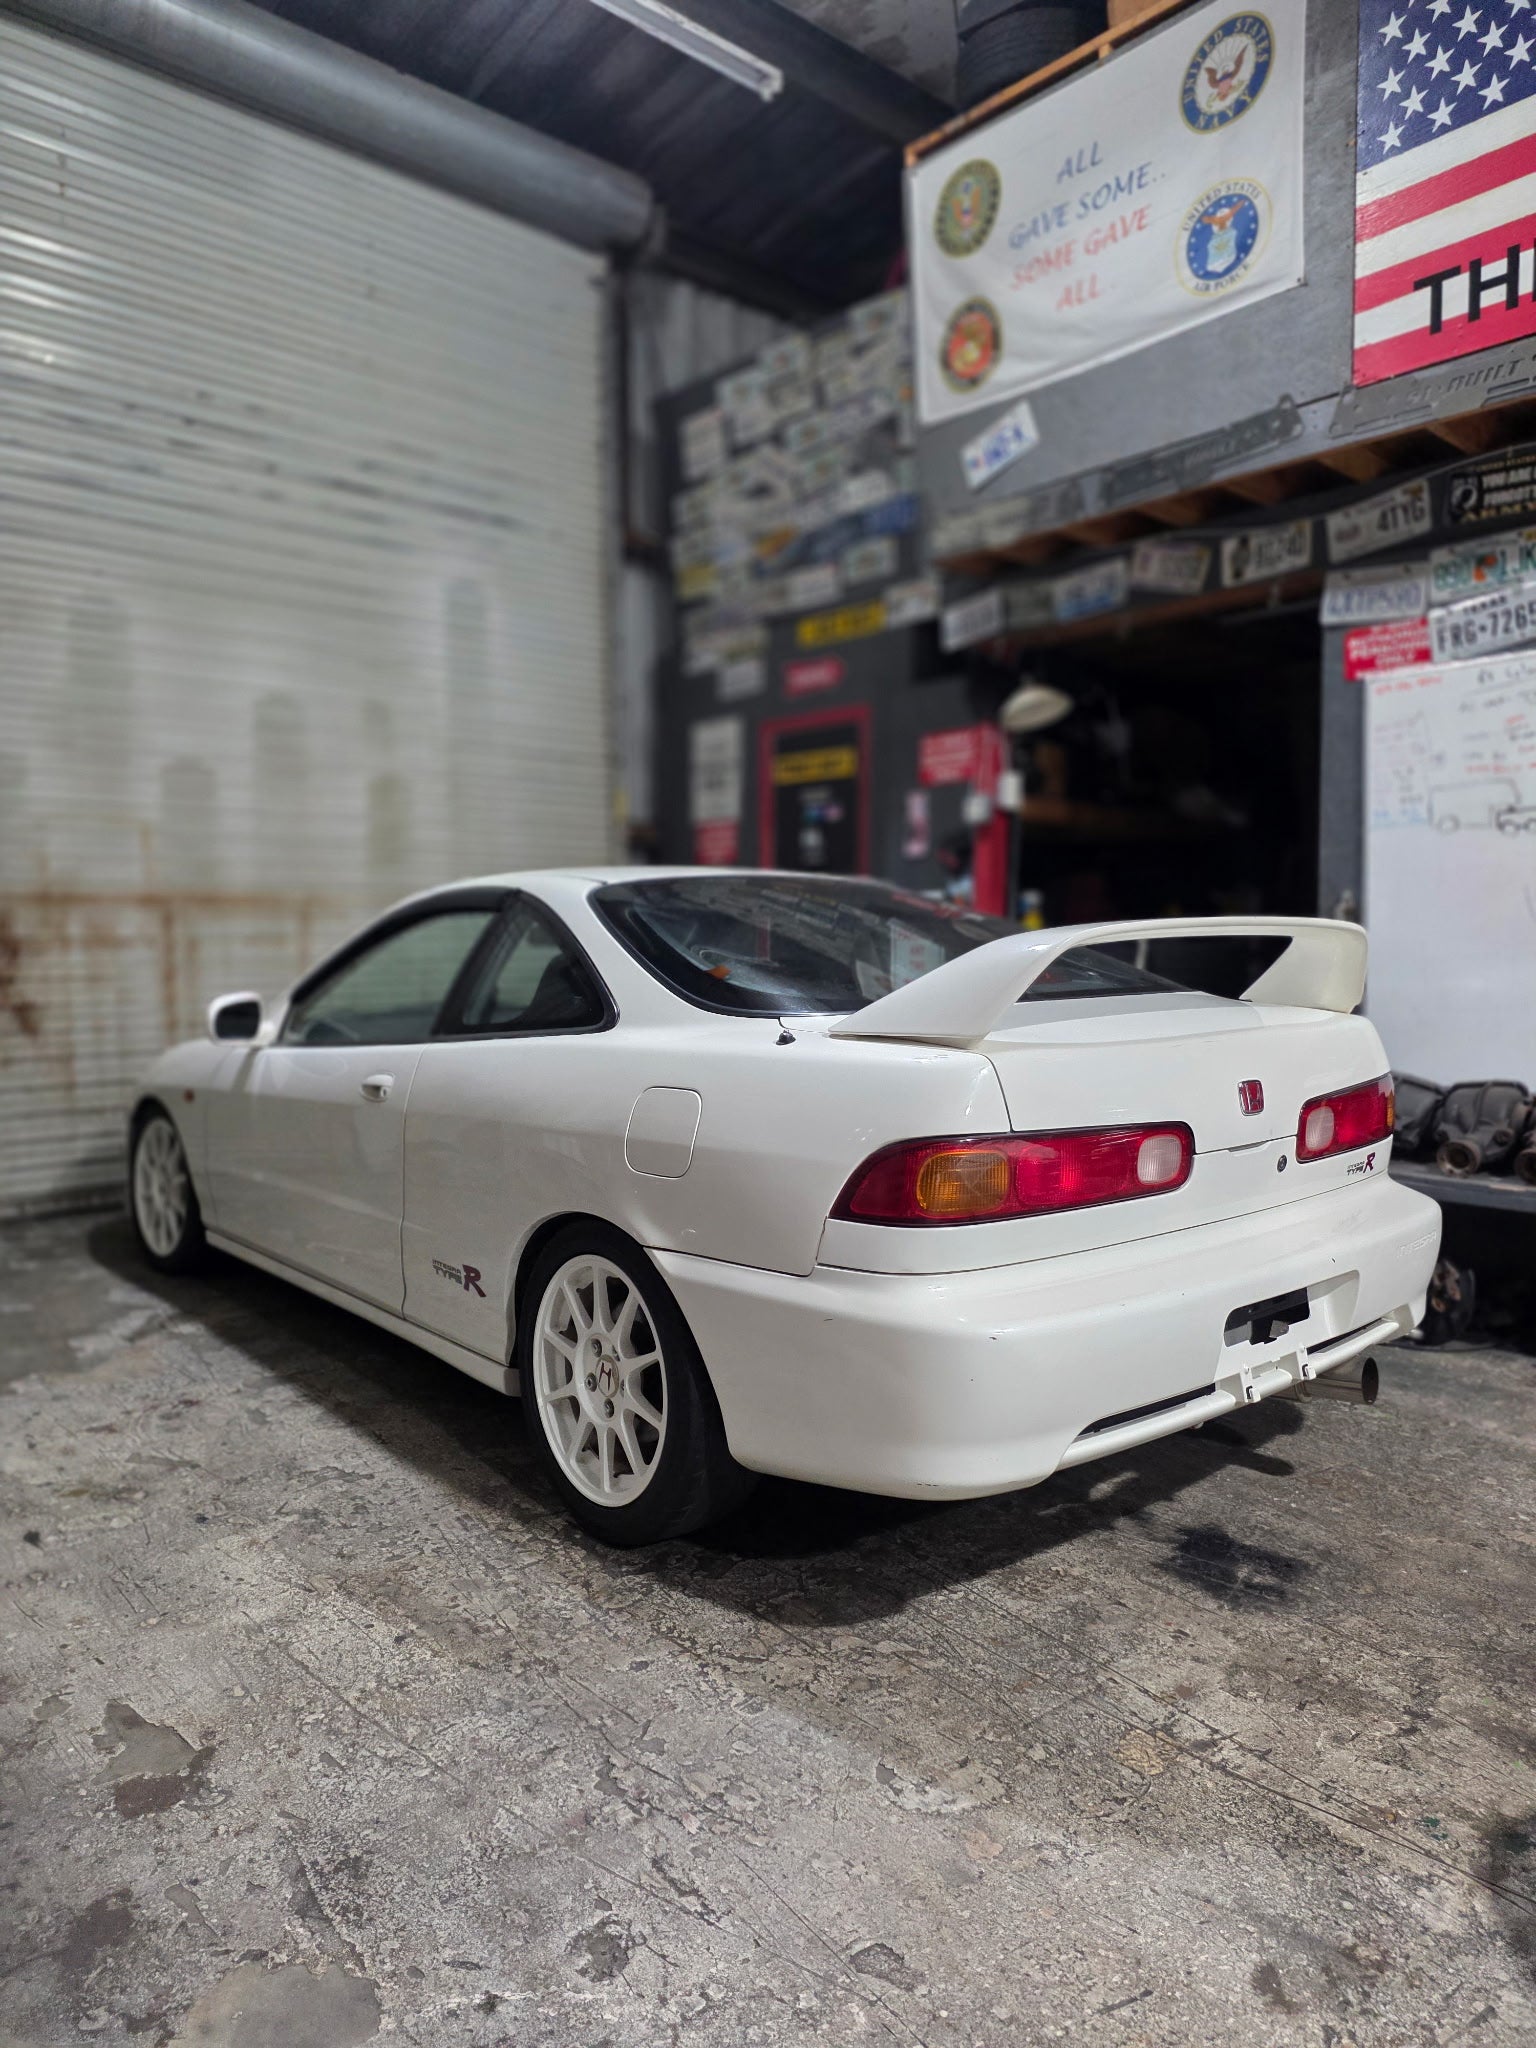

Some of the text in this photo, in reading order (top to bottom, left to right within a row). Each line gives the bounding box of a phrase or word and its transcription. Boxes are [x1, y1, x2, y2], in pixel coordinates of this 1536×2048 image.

[1234, 18, 1269, 63] STATES
[1196, 84, 1250, 128] NAVY
[1056, 141, 1103, 185] ALL
[1008, 202, 1070, 250] GAVE
[1182, 182, 1262, 232] UNITED STATES
[1009, 203, 1152, 292] SOME GAVE
[1056, 272, 1101, 313] ALL
[1362, 1151, 1376, 1174] R
[432, 1263, 487, 1298] TYPE R
